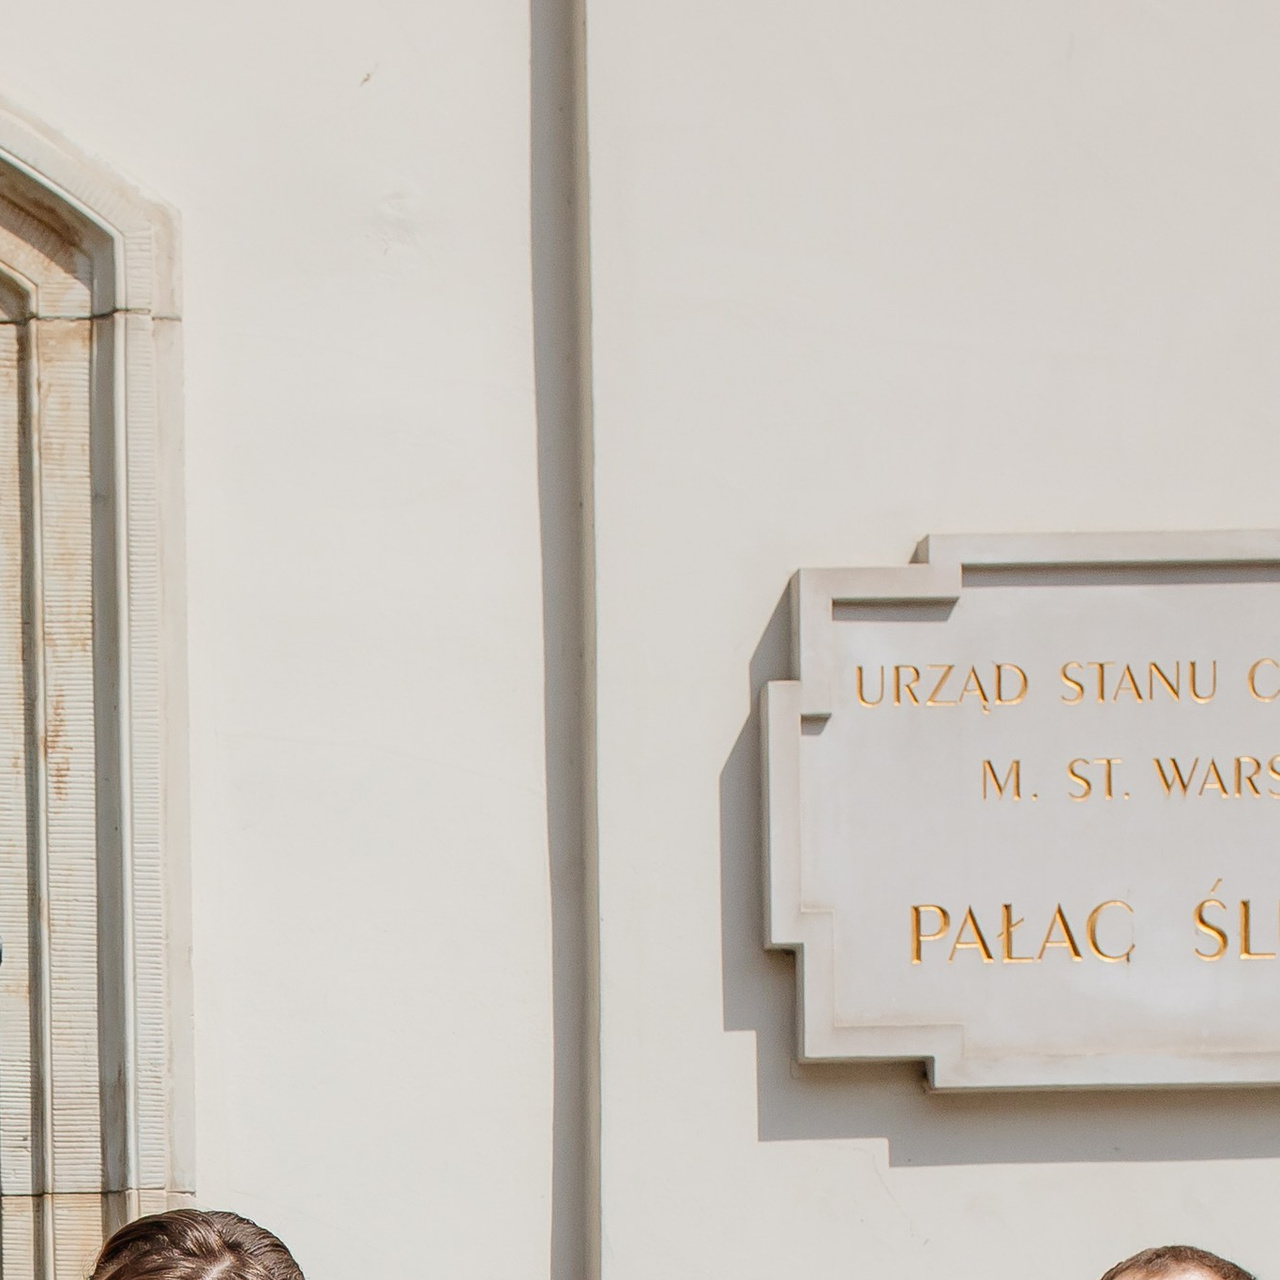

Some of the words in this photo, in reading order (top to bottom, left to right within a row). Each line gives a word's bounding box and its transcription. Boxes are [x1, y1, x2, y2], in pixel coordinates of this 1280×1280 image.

[856, 661, 1029, 714] URZĄD
[1060, 659, 1218, 704] STANU
[1247, 658, 1280, 702] C
[981, 758, 1039, 801] M.
[1067, 757, 1130, 801] ST.
[909, 900, 1136, 963] PAŁAC
[1193, 878, 1280, 961] ŚL
